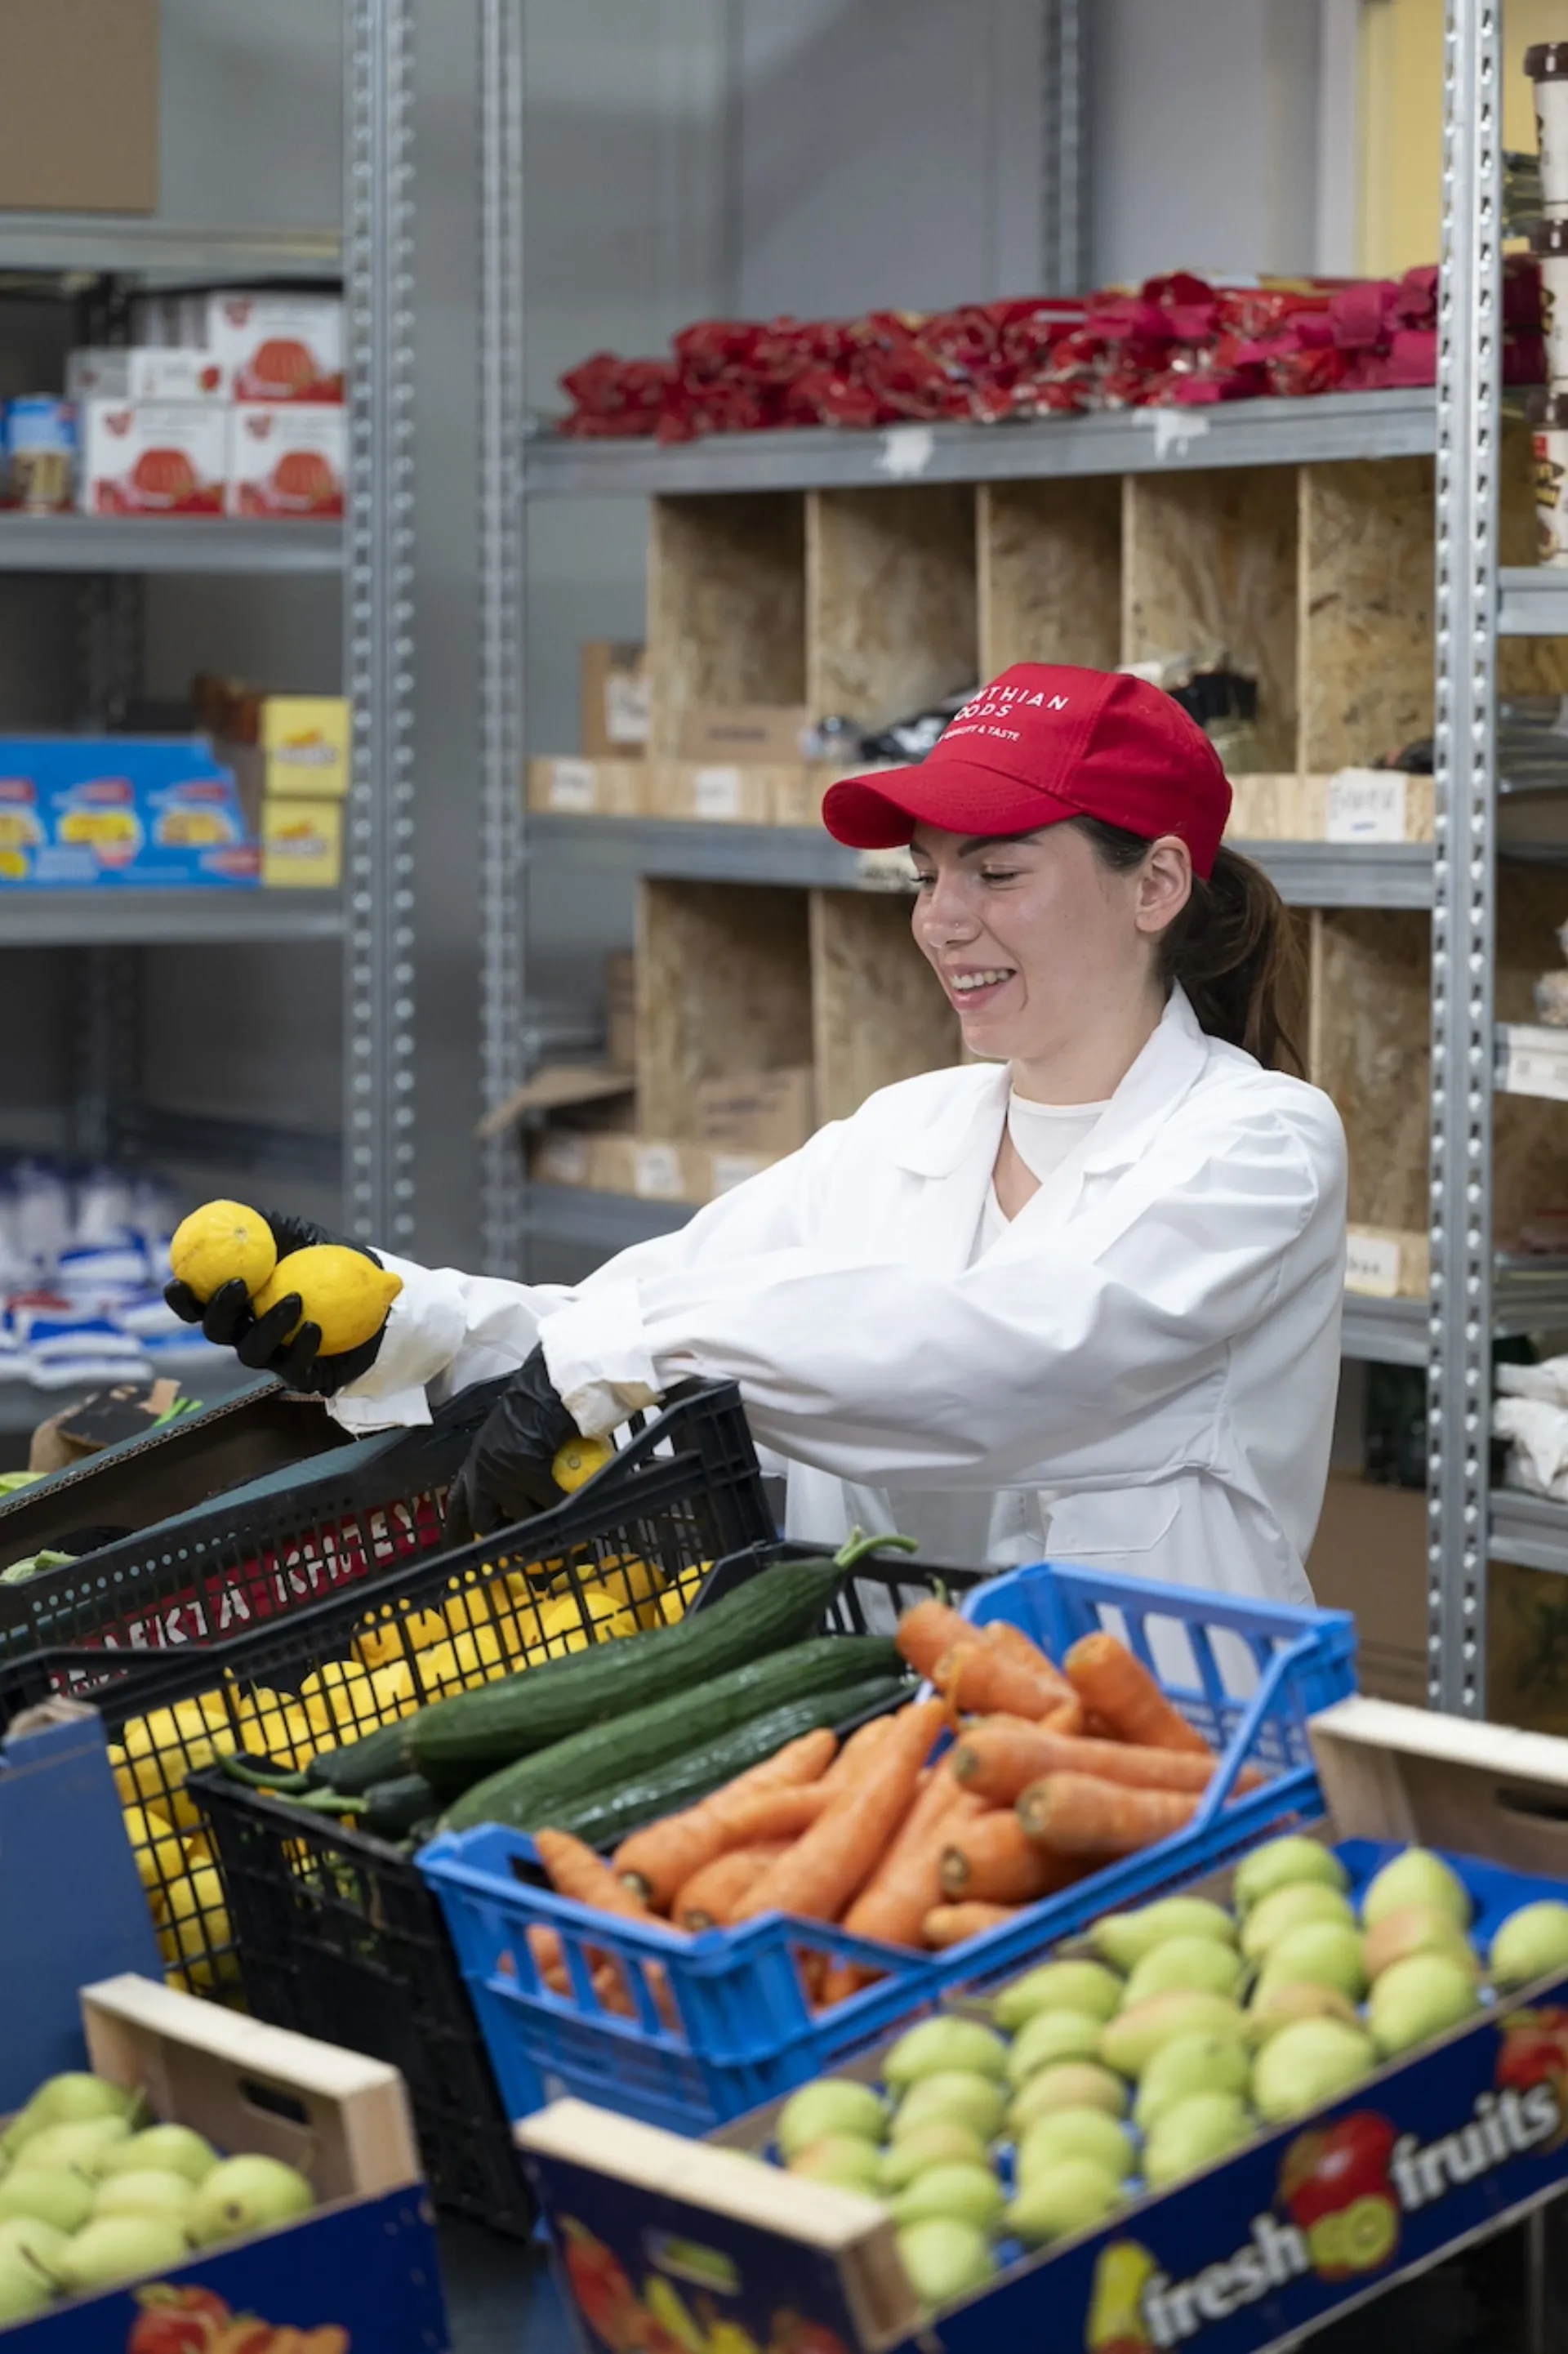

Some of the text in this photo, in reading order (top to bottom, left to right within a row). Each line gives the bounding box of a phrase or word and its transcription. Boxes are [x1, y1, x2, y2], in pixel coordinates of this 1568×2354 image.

[954, 702, 1013, 721] OODS
[987, 725, 1021, 742] TASTE
[1143, 2081, 1558, 2347] fresh fruits
